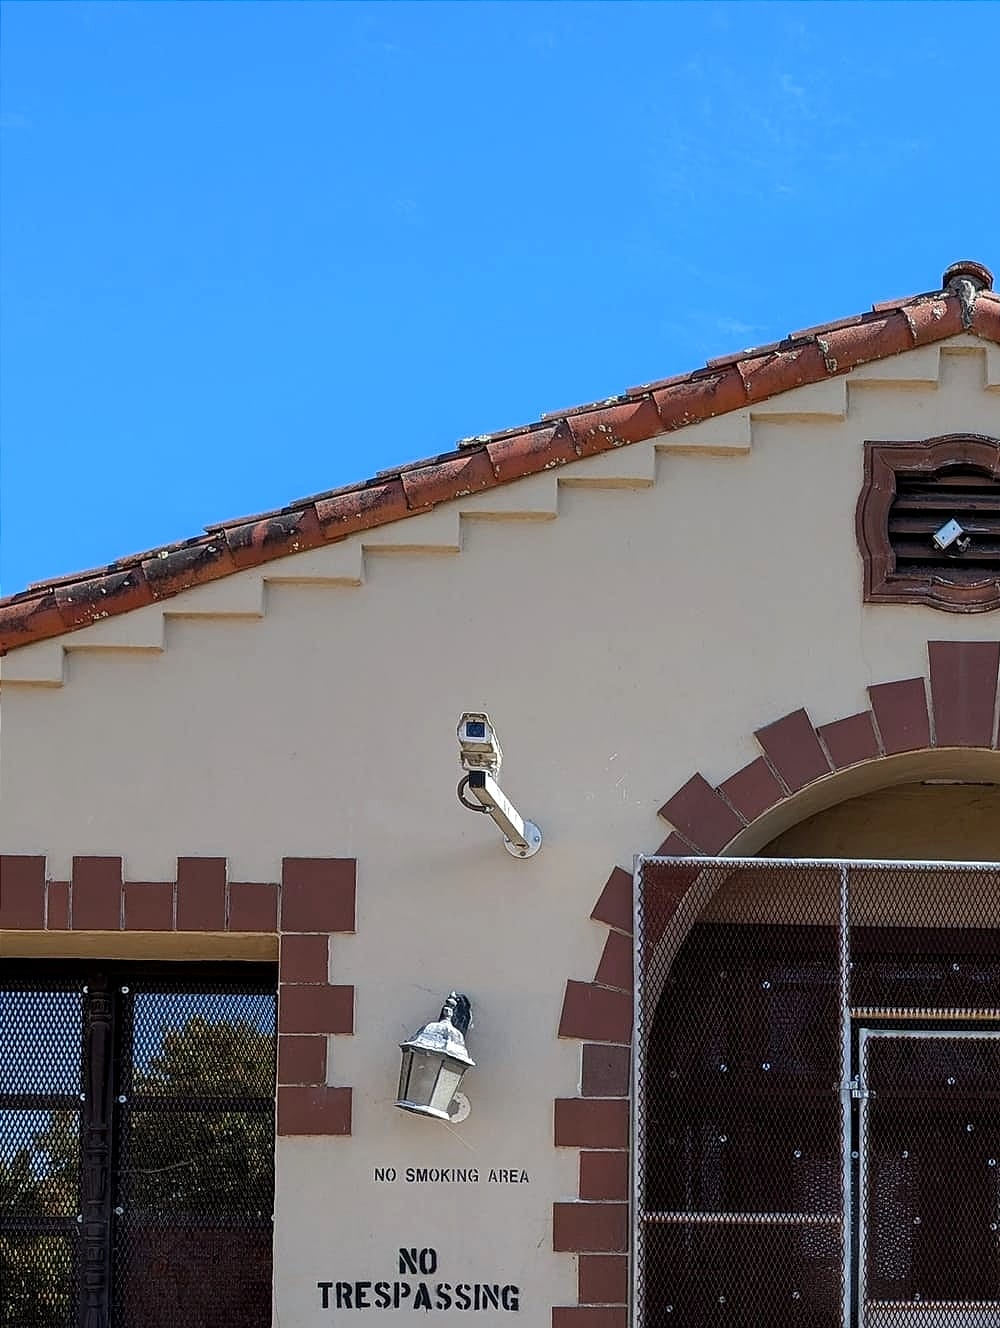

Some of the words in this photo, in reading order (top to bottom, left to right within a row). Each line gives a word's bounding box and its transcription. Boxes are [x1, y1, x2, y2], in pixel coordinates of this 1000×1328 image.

[374, 1167, 396, 1182] NO
[405, 1167, 479, 1183] SMOKING
[488, 1169, 530, 1183] AREA
[399, 1248, 437, 1275] NO
[317, 1281, 520, 1311] TRESPASSING
